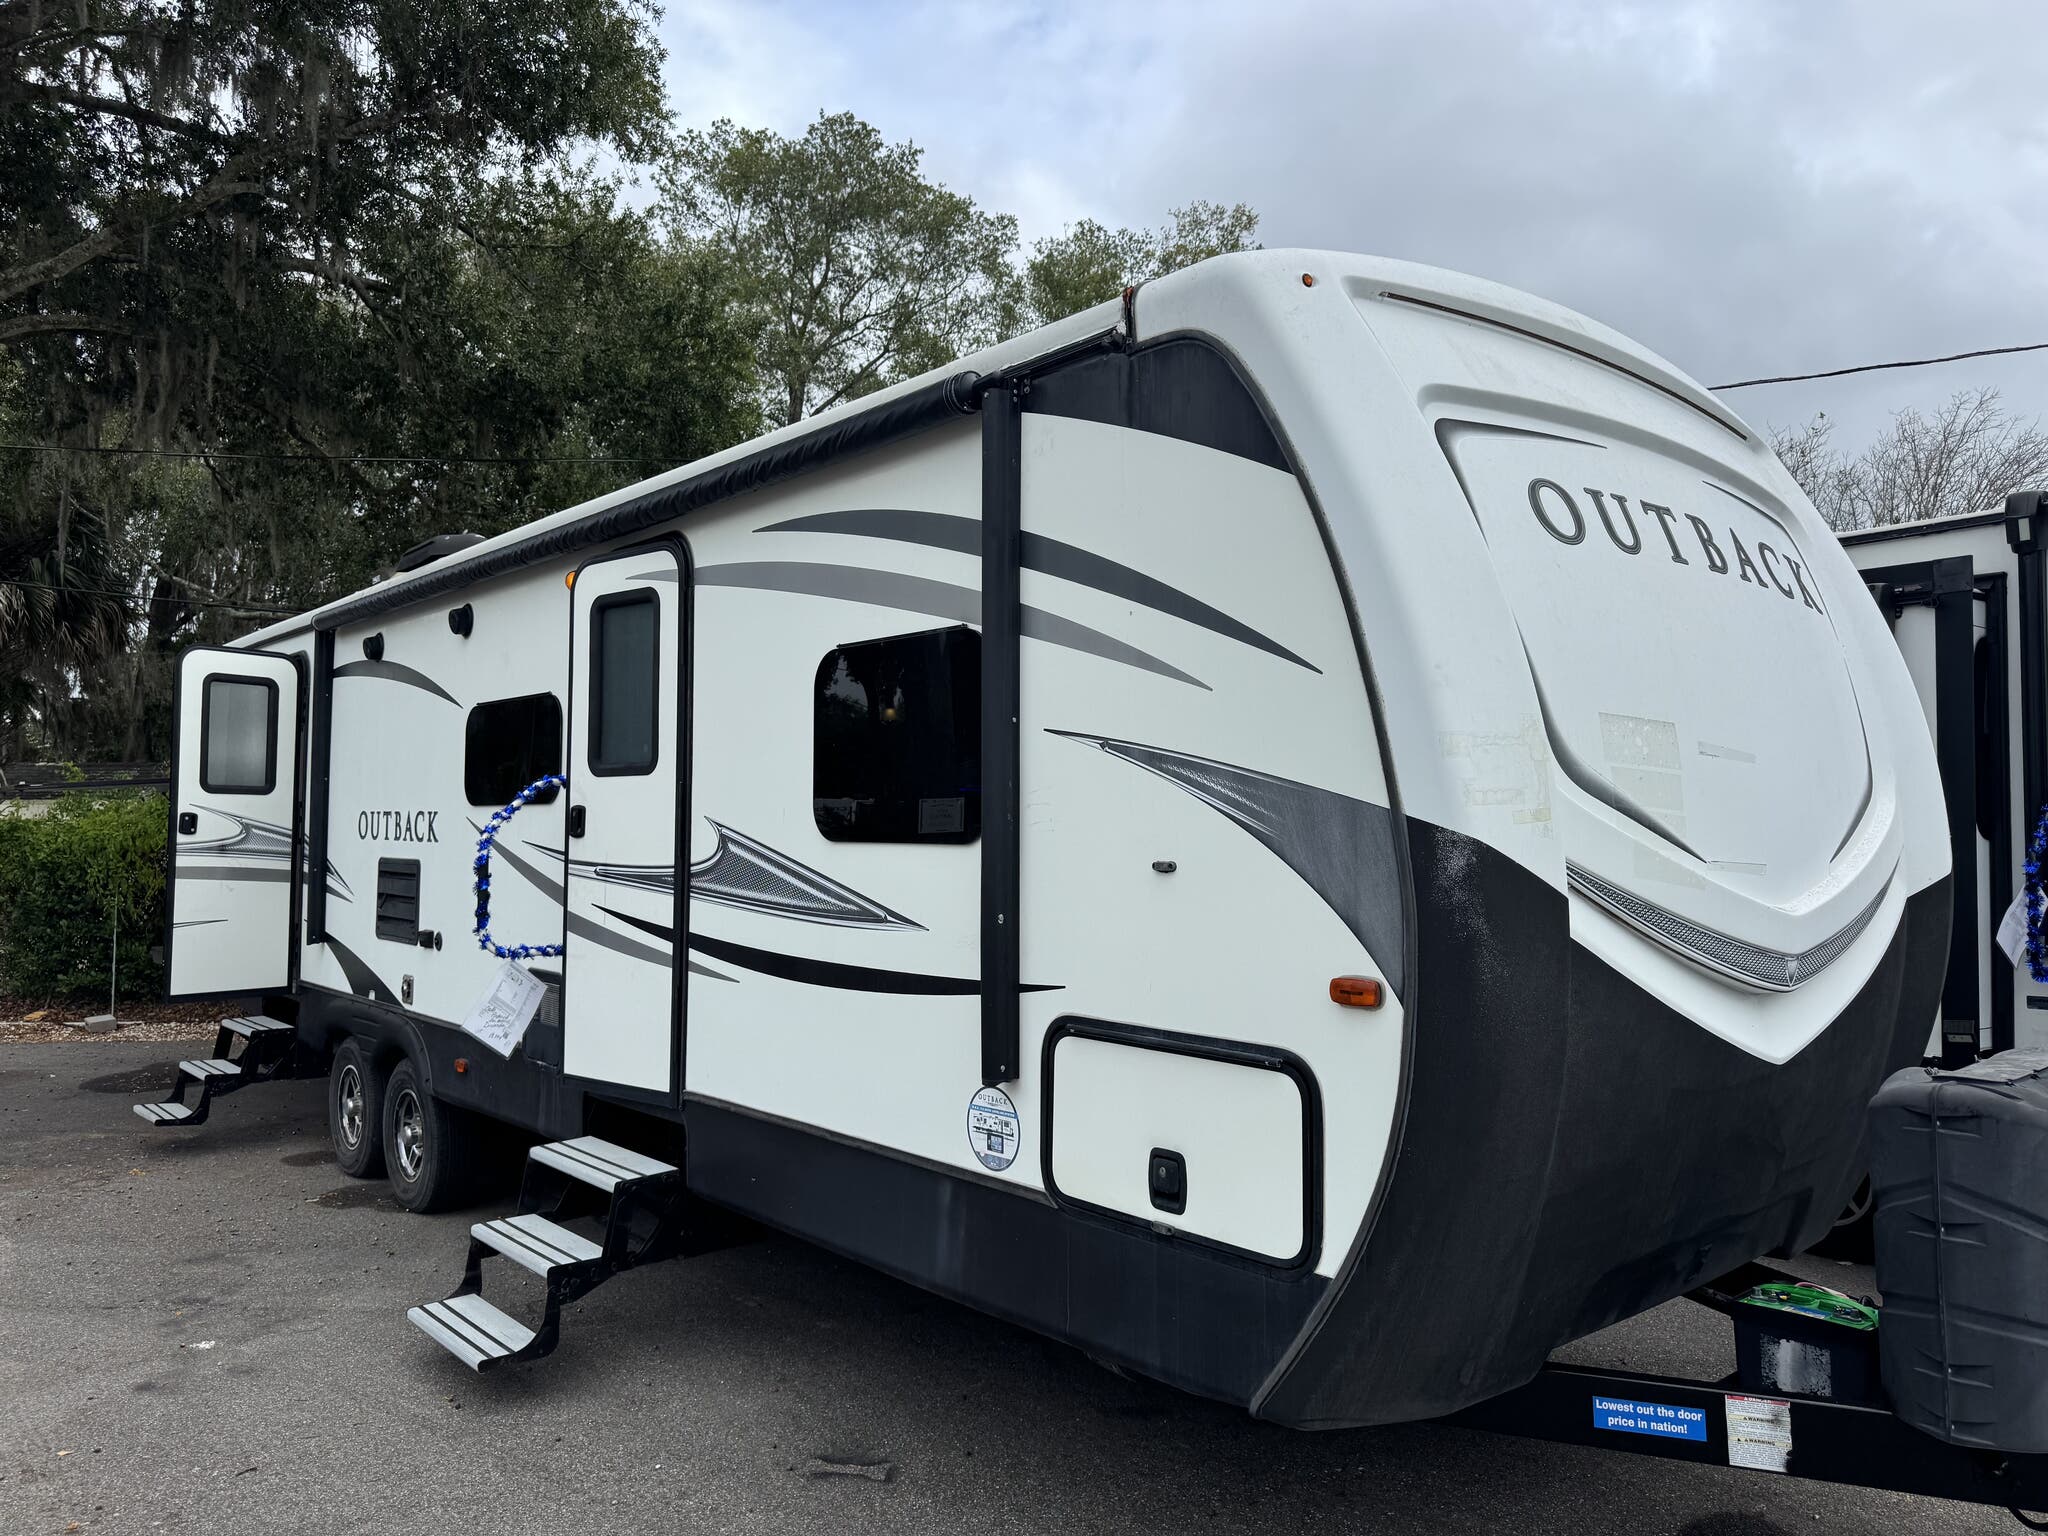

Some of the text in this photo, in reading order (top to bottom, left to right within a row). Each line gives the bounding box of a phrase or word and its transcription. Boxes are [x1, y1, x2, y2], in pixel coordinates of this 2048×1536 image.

[1527, 477, 1824, 616] OUTBACK
[358, 810, 439, 843] OUTBACK
[978, 1093, 1009, 1106] OUTBACK
[1595, 1399, 1703, 1422] Lowest out the door
[1607, 1416, 1688, 1434] price in nation!
[1749, 1438, 1776, 1446] WARNING
